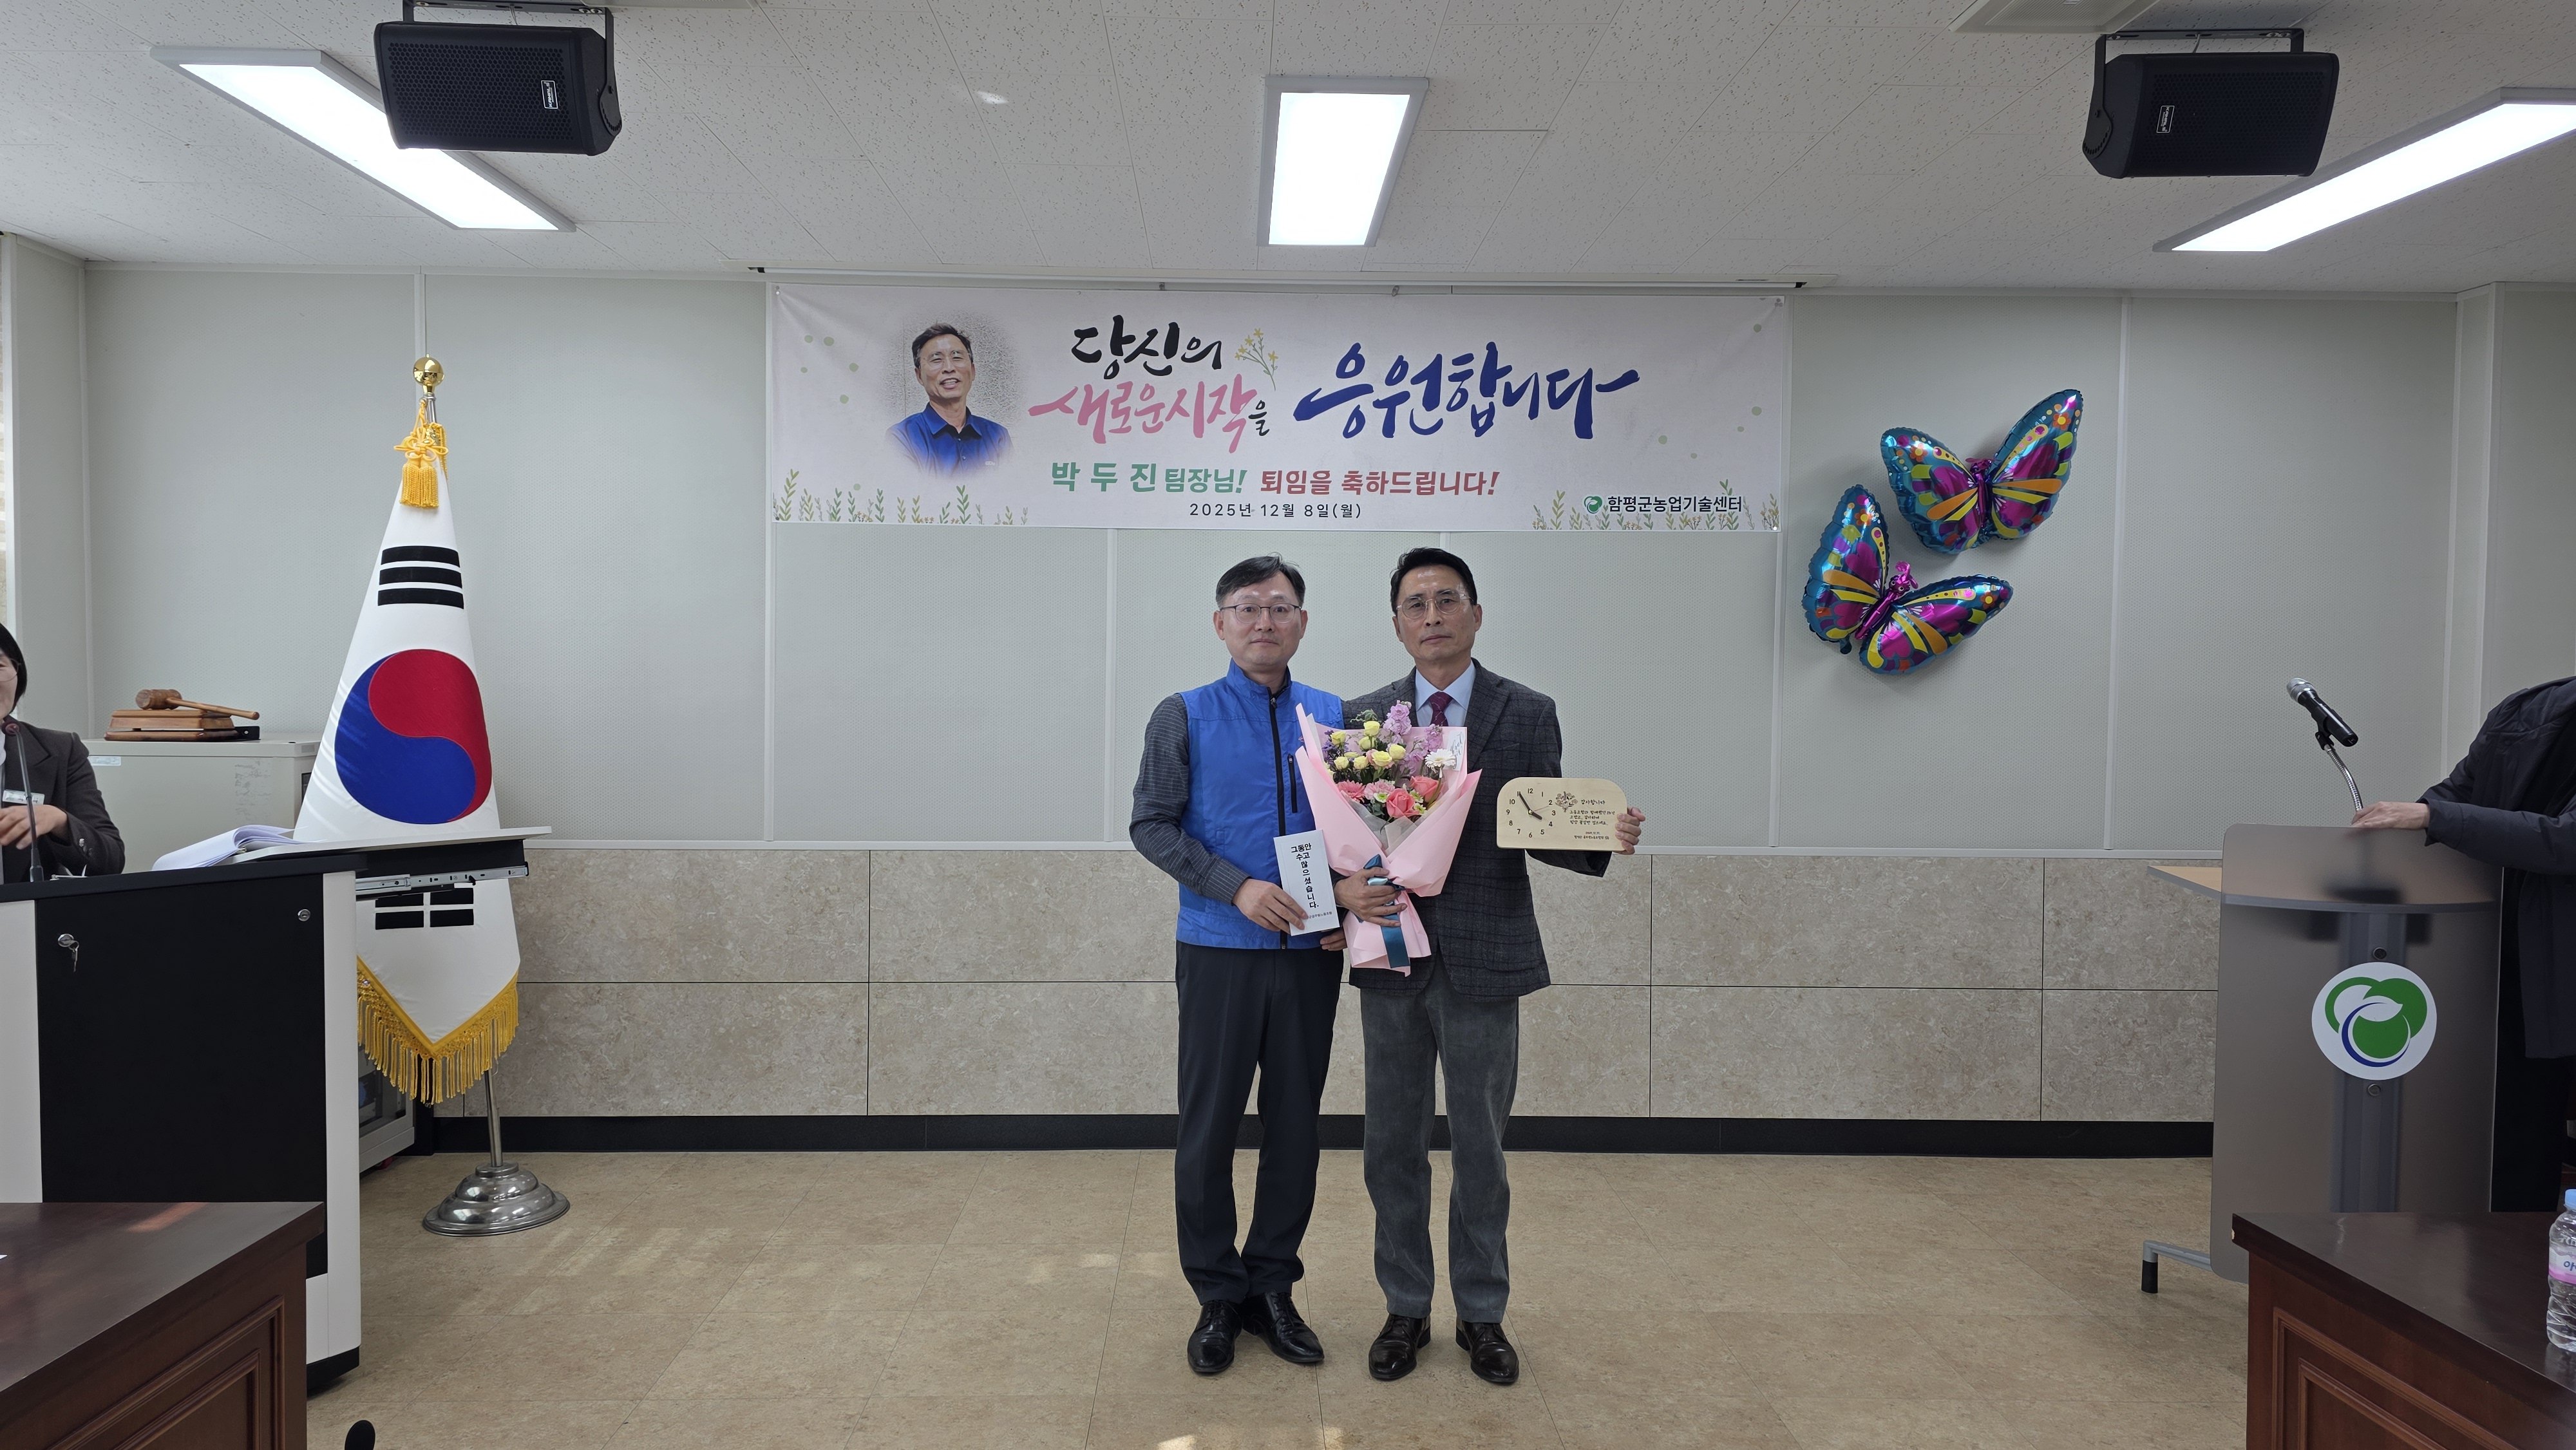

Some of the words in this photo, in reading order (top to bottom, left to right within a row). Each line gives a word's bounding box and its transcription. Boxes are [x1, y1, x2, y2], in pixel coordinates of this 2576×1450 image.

[1071, 314, 1222, 380] 당신의
[1293, 341, 1640, 440] 응원합니다
[1028, 374, 1270, 453] 새로운시작을
[1052, 462, 1081, 492] 박
[1090, 462, 1117, 492] 두
[1130, 463, 1157, 493] 진
[1164, 468, 1247, 494] 팀장님!
[1260, 470, 1331, 495] 퇴임을
[1341, 471, 1500, 496] 축하드립니다!
[1189, 503, 1251, 517] 2025년
[1260, 504, 1294, 518] 12월
[1304, 504, 1361, 519] 8일(월)
[1607, 496, 1742, 513] 함평군농업기술센터
[1291, 842, 1312, 853] 그동안
[1296, 852, 1311, 861] 수고
